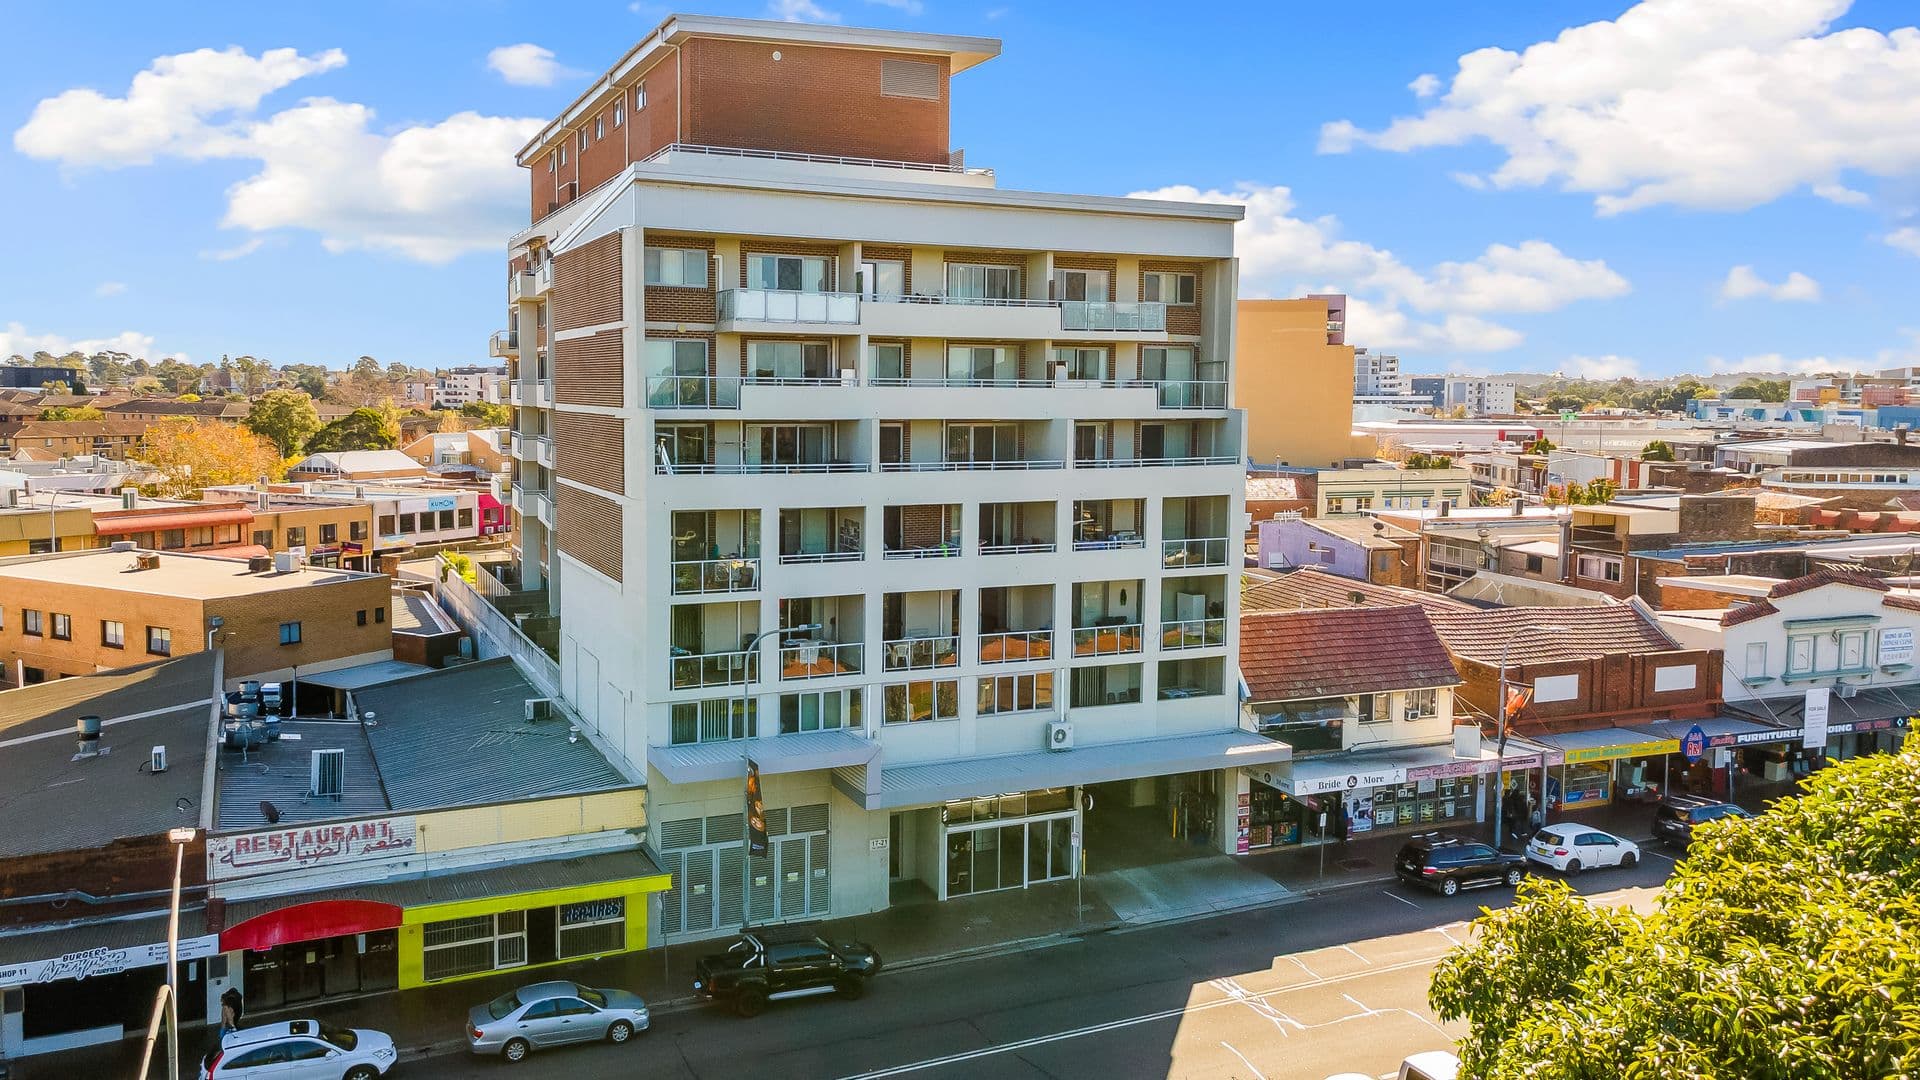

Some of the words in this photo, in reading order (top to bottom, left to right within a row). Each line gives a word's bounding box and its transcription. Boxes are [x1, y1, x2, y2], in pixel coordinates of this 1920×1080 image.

[431, 499, 454, 507] KUMON
[1737, 730, 1797, 743] FURNITURE
[1318, 780, 1341, 790] Bride
[1363, 775, 1385, 784] More
[235, 820, 391, 855] RESTAURANT
[62, 948, 107, 962] BURGERS
[19, 968, 27, 976] 11
